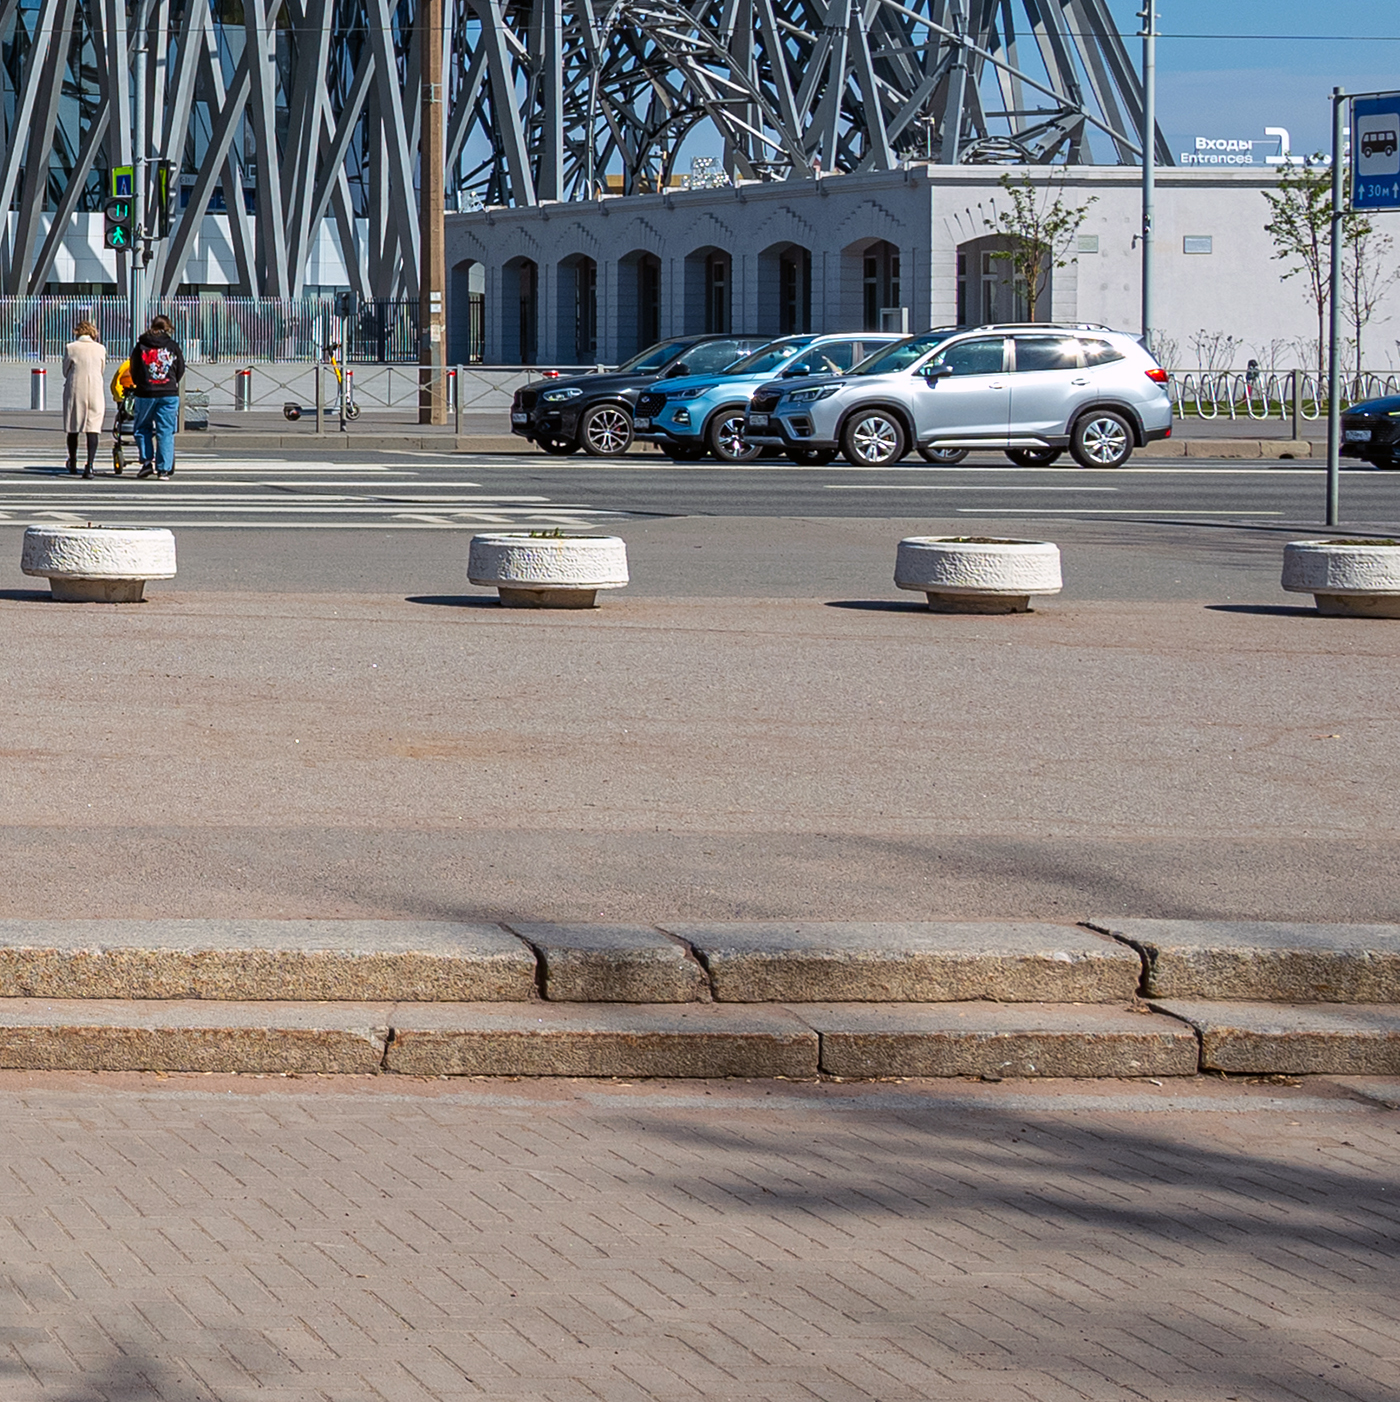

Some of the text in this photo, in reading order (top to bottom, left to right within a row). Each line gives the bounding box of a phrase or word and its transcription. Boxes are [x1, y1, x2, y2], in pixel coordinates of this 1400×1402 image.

[1195, 136, 1253, 152] Входы
[1180, 152, 1253, 164] Entrances
[116, 204, 128, 217] 11
